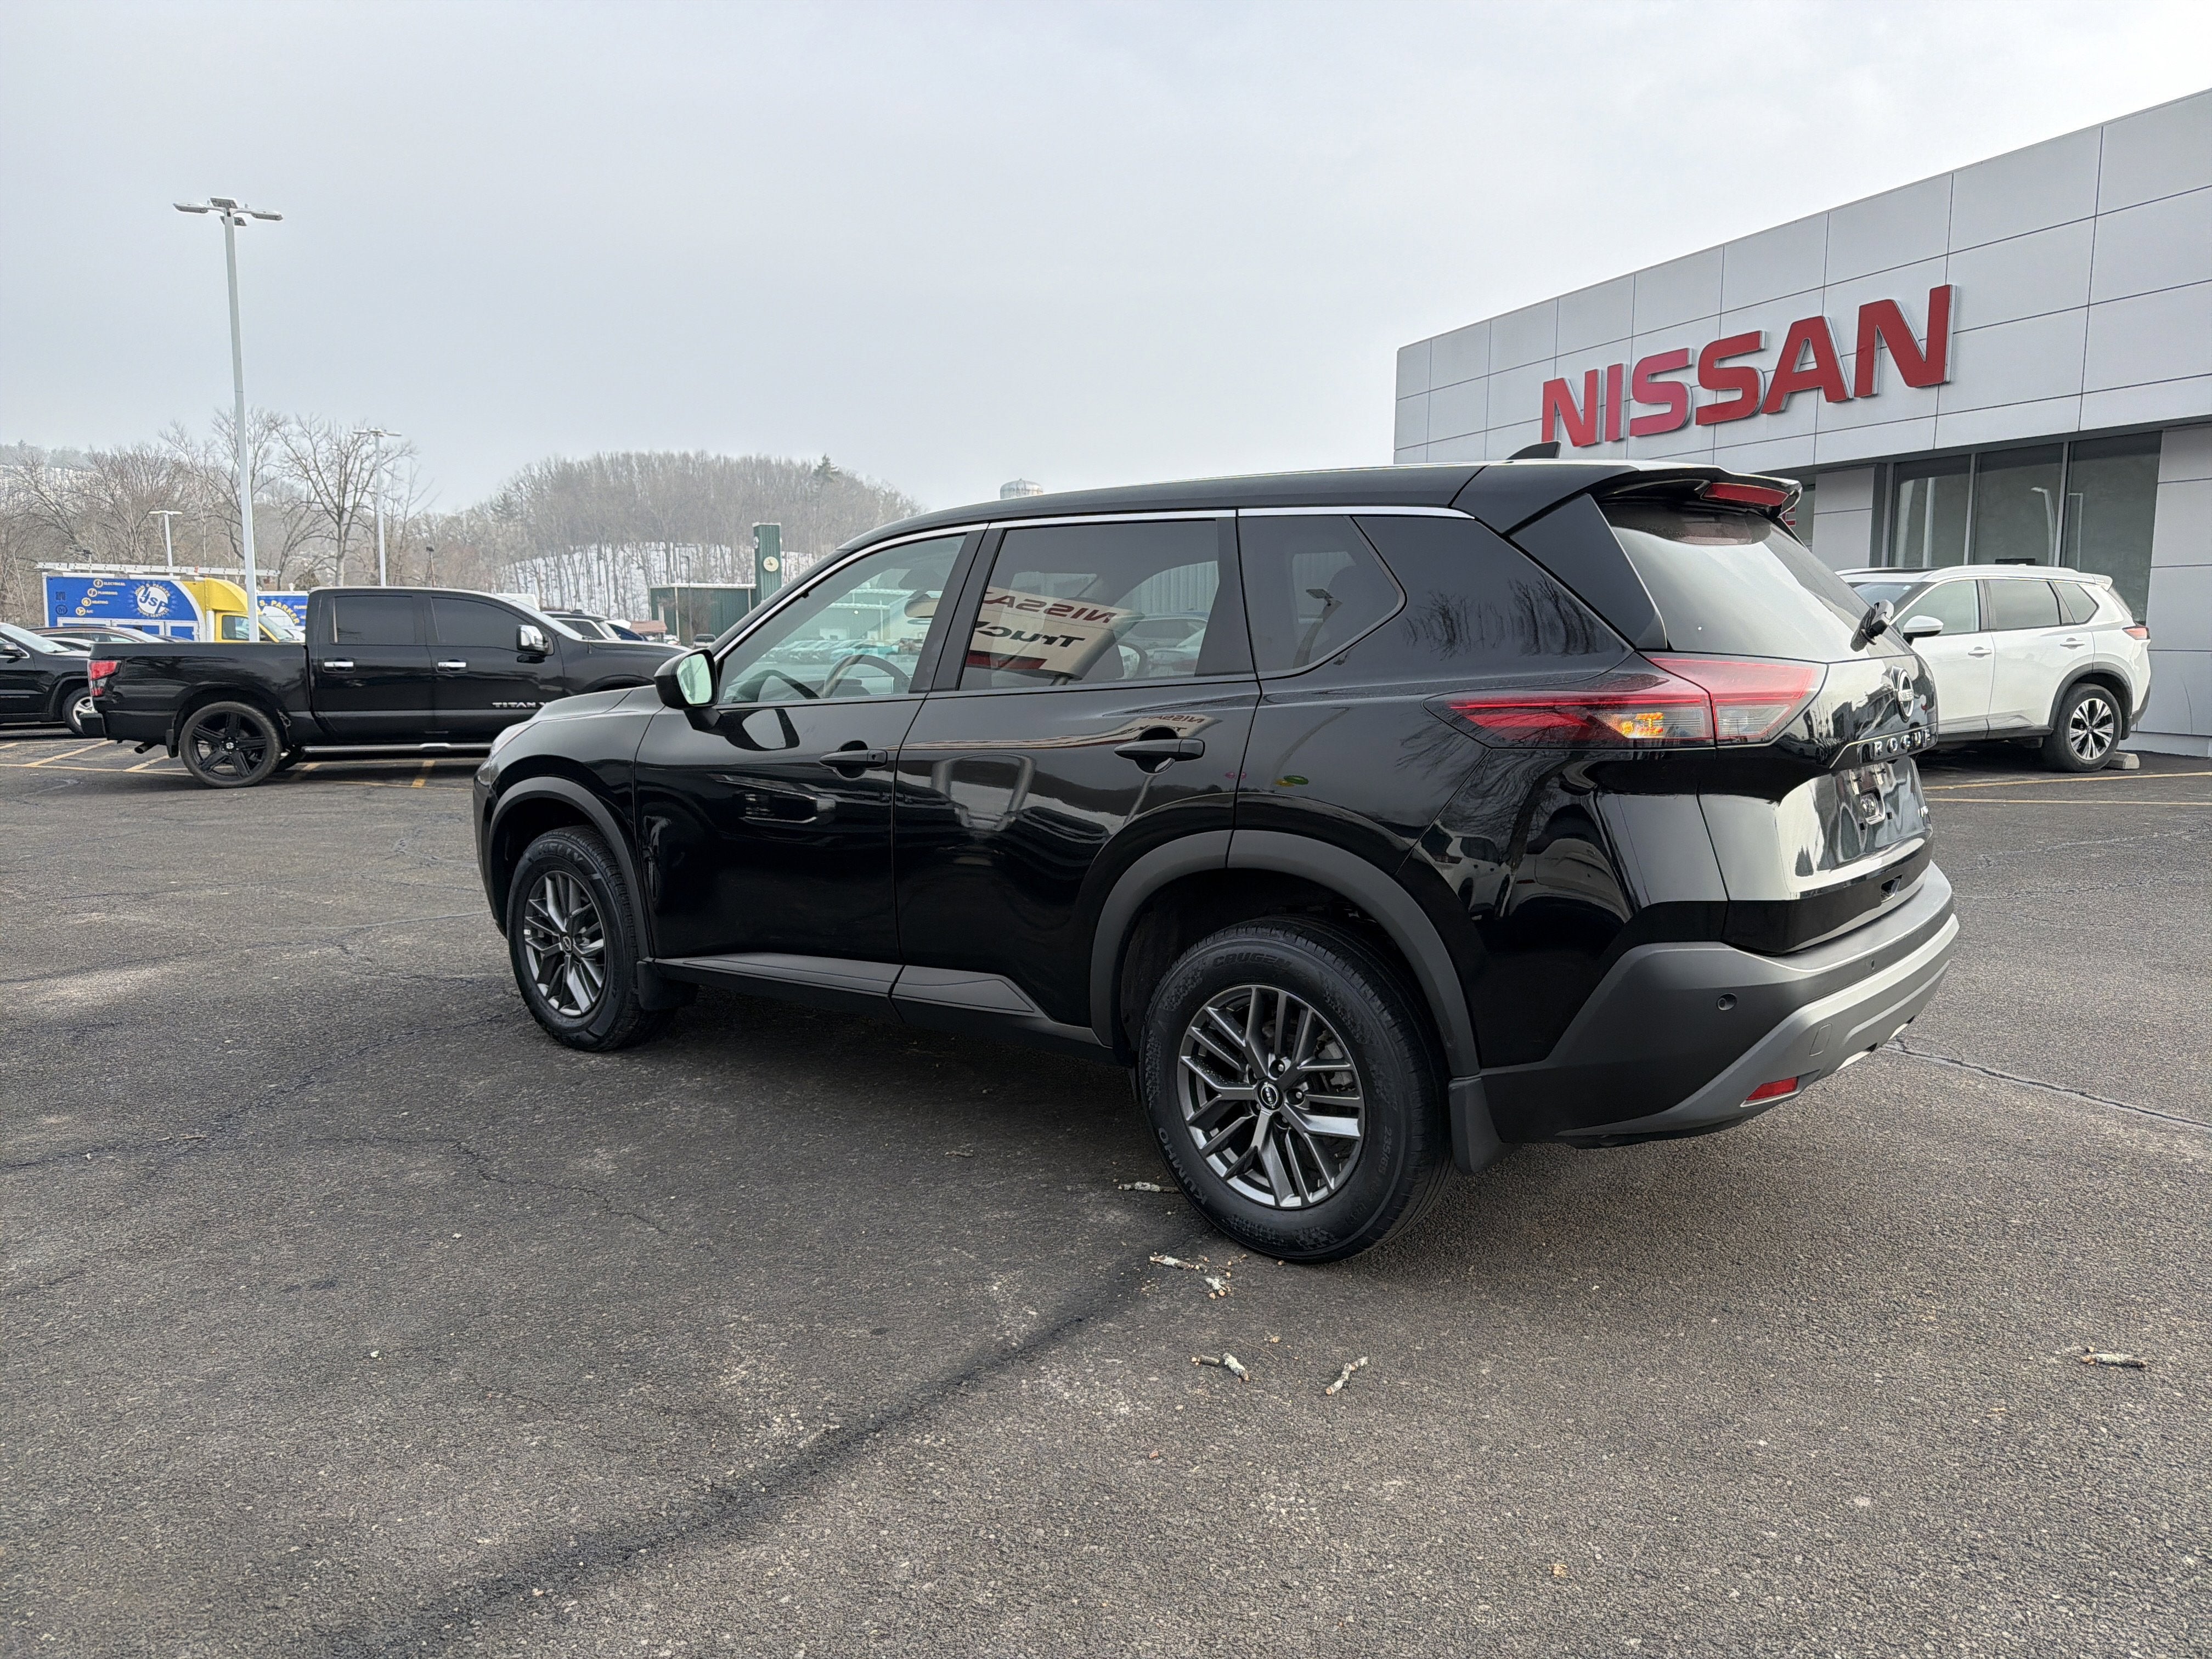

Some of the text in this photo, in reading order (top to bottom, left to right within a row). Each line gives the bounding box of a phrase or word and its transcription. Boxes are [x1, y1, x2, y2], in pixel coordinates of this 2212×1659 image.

[1541, 284, 1957, 448] NISSAN
[153, 584, 171, 597] PARKER
[271, 600, 300, 624] PARKER
[1871, 729, 1931, 757] ROGUE
[1212, 952, 1293, 970] CRUGEN
[1158, 1127, 1208, 1205] KUMHO
